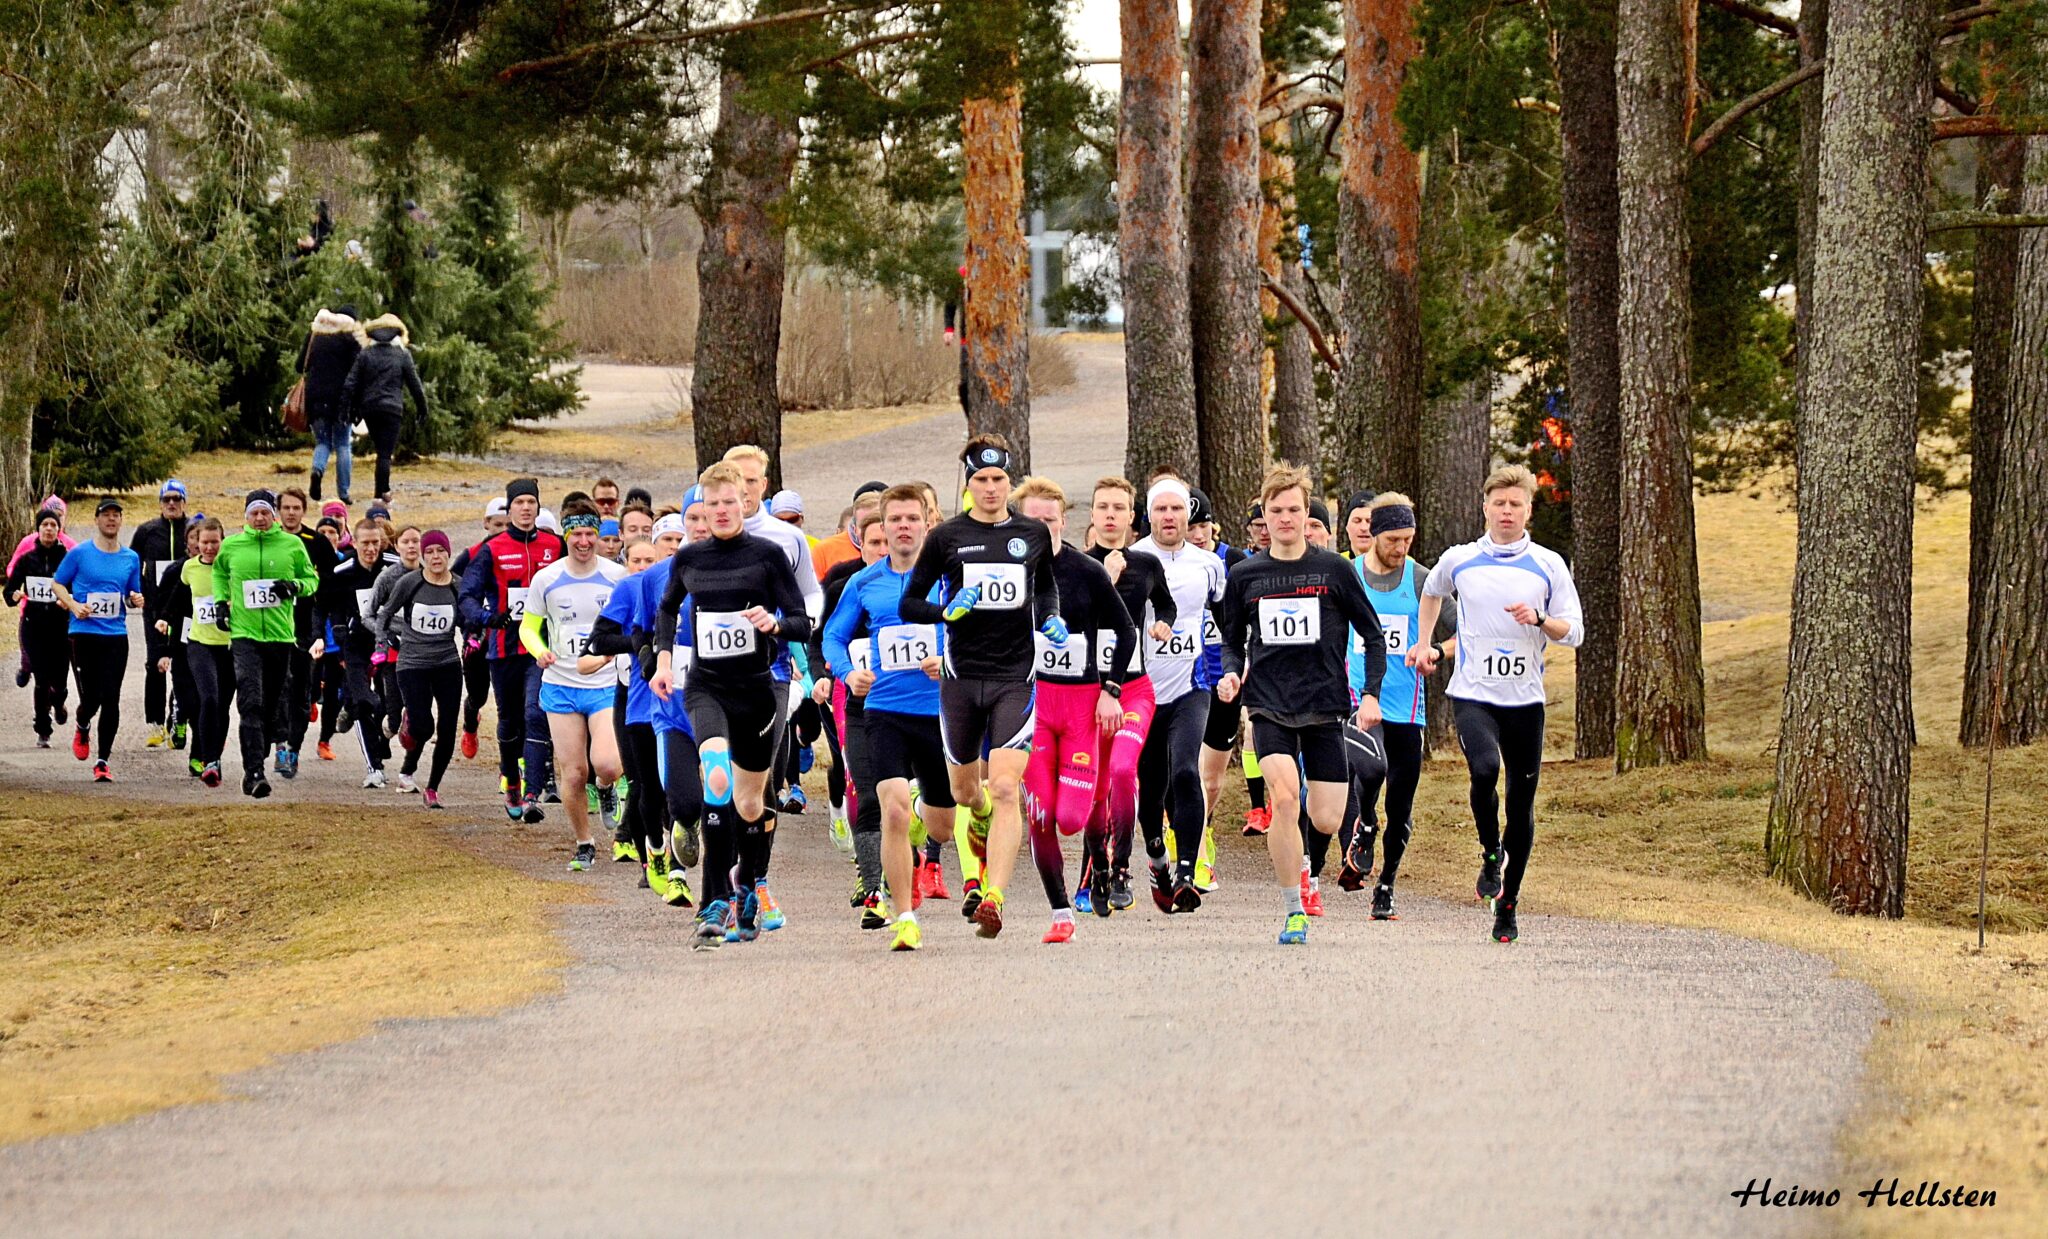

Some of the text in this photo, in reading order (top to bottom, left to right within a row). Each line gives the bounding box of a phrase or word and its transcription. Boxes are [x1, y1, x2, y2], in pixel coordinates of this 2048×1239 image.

[31, 587, 52, 599] 144
[249, 590, 276, 604] 135
[975, 581, 1016, 602] 109
[1296, 586, 1328, 595] HALTI
[91, 602, 115, 614] 241
[418, 616, 448, 630] 140
[1268, 616, 1309, 637] 101
[705, 629, 747, 651] 108
[1155, 634, 1196, 655] 264
[888, 640, 929, 664] 113
[1043, 650, 1072, 669] 94
[1483, 654, 1526, 677] 105
